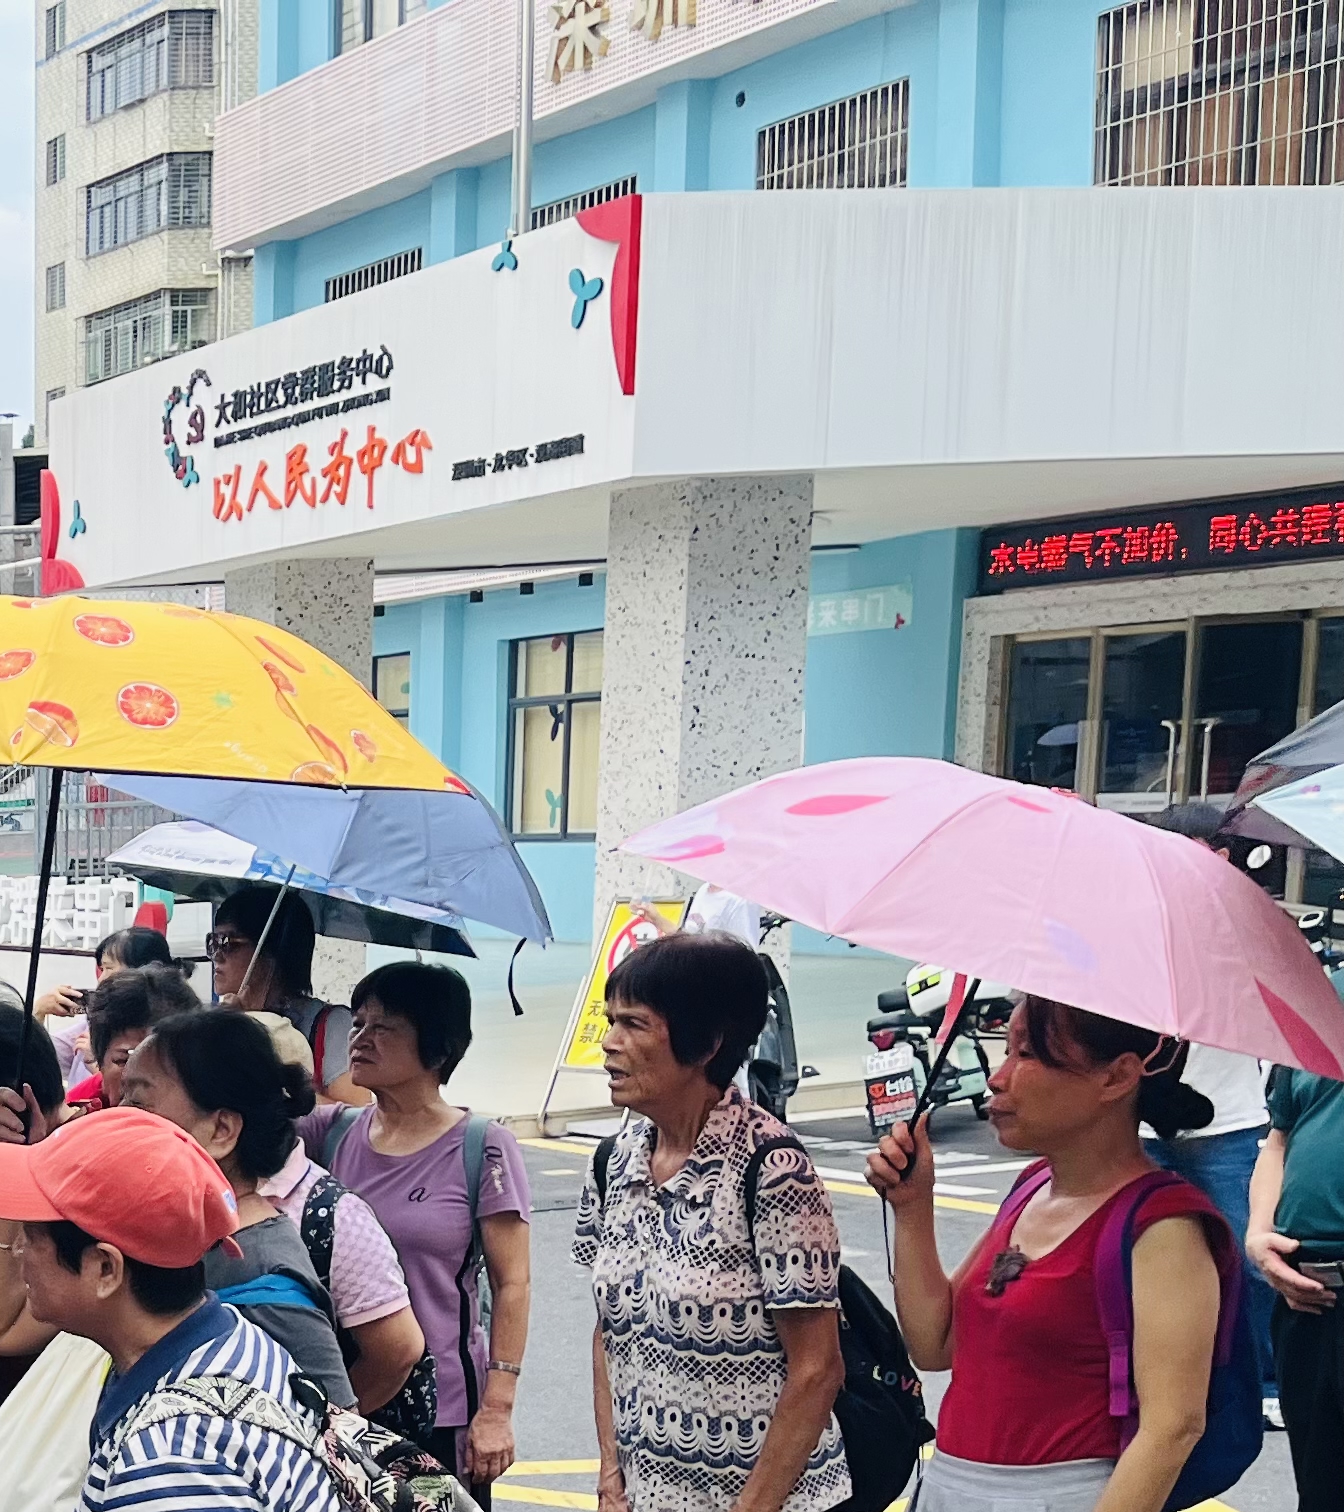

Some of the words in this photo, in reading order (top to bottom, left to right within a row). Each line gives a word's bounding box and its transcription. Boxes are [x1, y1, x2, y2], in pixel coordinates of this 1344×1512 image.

[214, 344, 394, 428] 大和社区党群服务中心
[213, 425, 433, 522] 以人民为中心
[807, 593, 885, 628] 来串门
